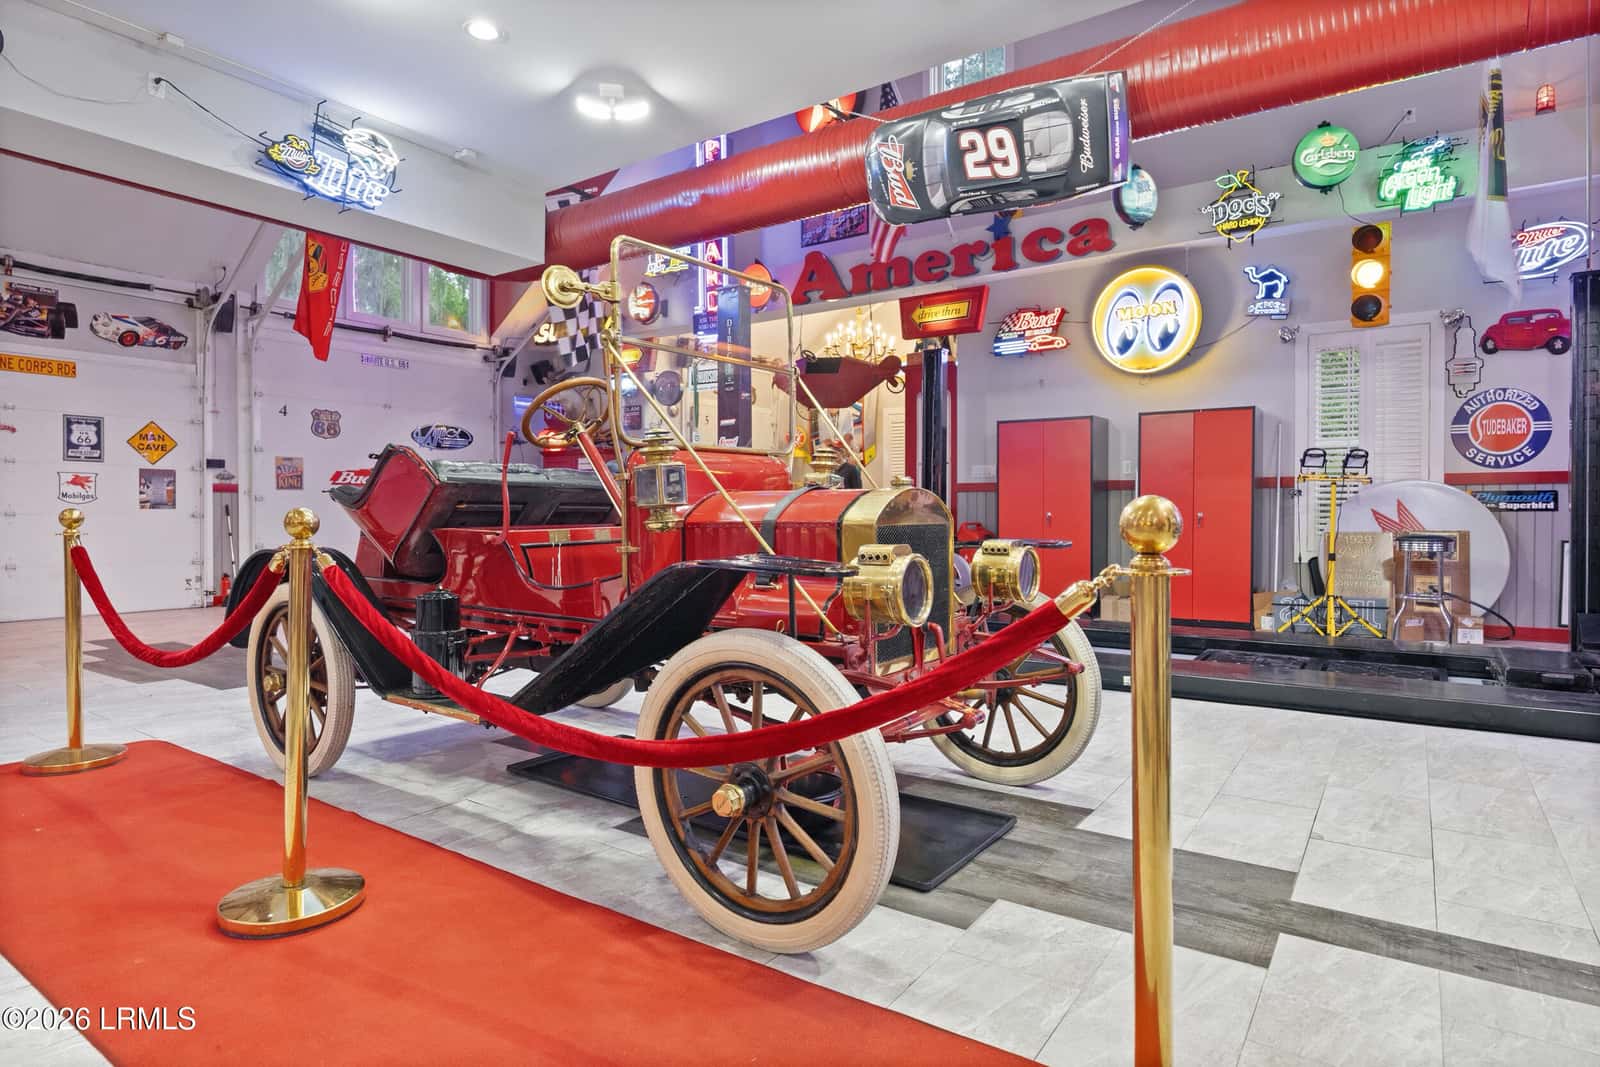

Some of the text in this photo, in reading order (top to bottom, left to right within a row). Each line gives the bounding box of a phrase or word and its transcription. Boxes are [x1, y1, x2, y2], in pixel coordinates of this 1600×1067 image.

[1078, 98, 1094, 173] Budweiser
[959, 127, 1020, 180] 29
[1300, 146, 1355, 167] Carlsberg
[880, 135, 919, 209] Bud
[788, 217, 1113, 305] America
[1014, 308, 1060, 330] Bud
[1116, 300, 1178, 320] MOON
[18, 359, 53, 373] CORPS
[278, 405, 287, 416] 4
[1463, 388, 1540, 415] AUTHORIZED
[140, 433, 165, 442] MAN
[1475, 411, 1527, 444] STUDEBAKER
[77, 434, 92, 444] 66
[138, 443, 168, 452] CAVE
[1465, 447, 1536, 467] SERVICE
[61, 491, 95, 501] Mobilgas
[1476, 491, 1552, 503] Plymouth
[1499, 502, 1554, 510] Superbird
